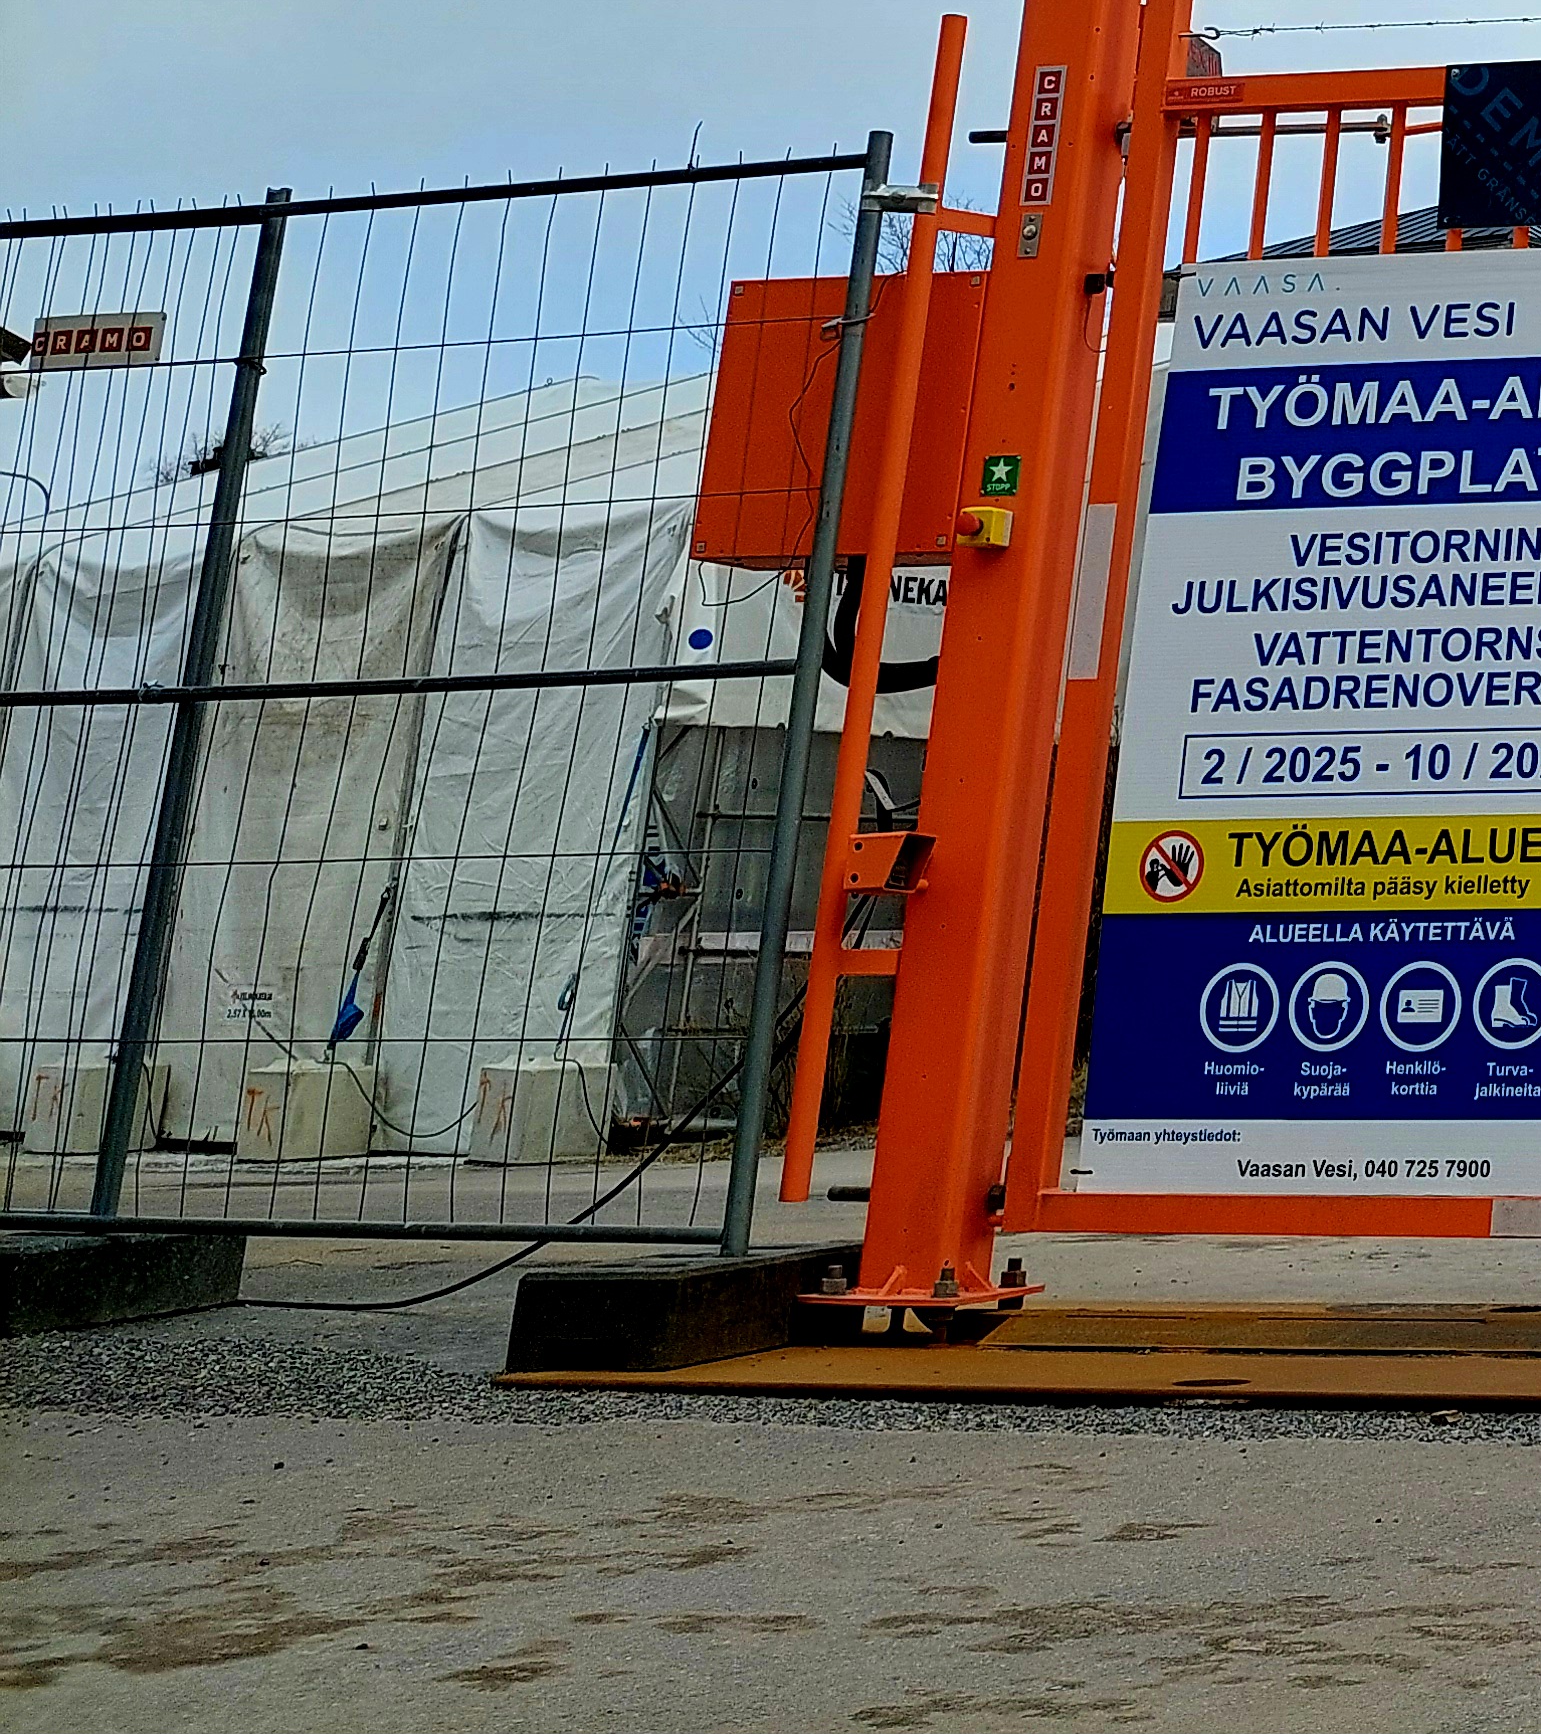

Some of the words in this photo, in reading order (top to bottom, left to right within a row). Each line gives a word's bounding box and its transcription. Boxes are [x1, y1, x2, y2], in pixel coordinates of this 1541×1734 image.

[1191, 86, 1236, 97] ROBUST
[1030, 75, 1056, 197] CRAMO
[1194, 306, 1390, 349] VAASAN
[1410, 301, 1516, 339] VESI
[35, 331, 146, 352] CRAMO
[1201, 748, 1226, 785] 2
[1236, 746, 1253, 784] /
[1262, 746, 1362, 783] 2025
[1404, 743, 1451, 781] 10
[1462, 742, 1478, 780] /
[1236, 876, 1365, 898] Asiattomilta
[1373, 877, 1437, 900] pääsy
[1444, 874, 1531, 899] kielletty
[1249, 923, 1363, 943] ALUEELLA
[1369, 917, 1516, 942] KÄYTETTÄVÄ
[1204, 1061, 1265, 1075] Huomio-
[1301, 1062, 1347, 1079] Suoja-
[1386, 1060, 1446, 1075] Henkilö-
[1487, 1062, 1533, 1077] Turva-
[1215, 1080, 1249, 1095] liiviä
[1293, 1081, 1350, 1099] kypärää
[1391, 1080, 1437, 1095] korttia
[1474, 1082, 1541, 1100] jalkineita
[1092, 1128, 1151, 1145] Työmaan
[1154, 1128, 1241, 1145] yhteystiedot:
[1237, 1160, 1306, 1178] Vaasan
[1312, 1160, 1357, 1182] Vesi,
[1364, 1160, 1398, 1178] 040
[1404, 1160, 1439, 1178] 725
[1444, 1159, 1491, 1177] 7900
